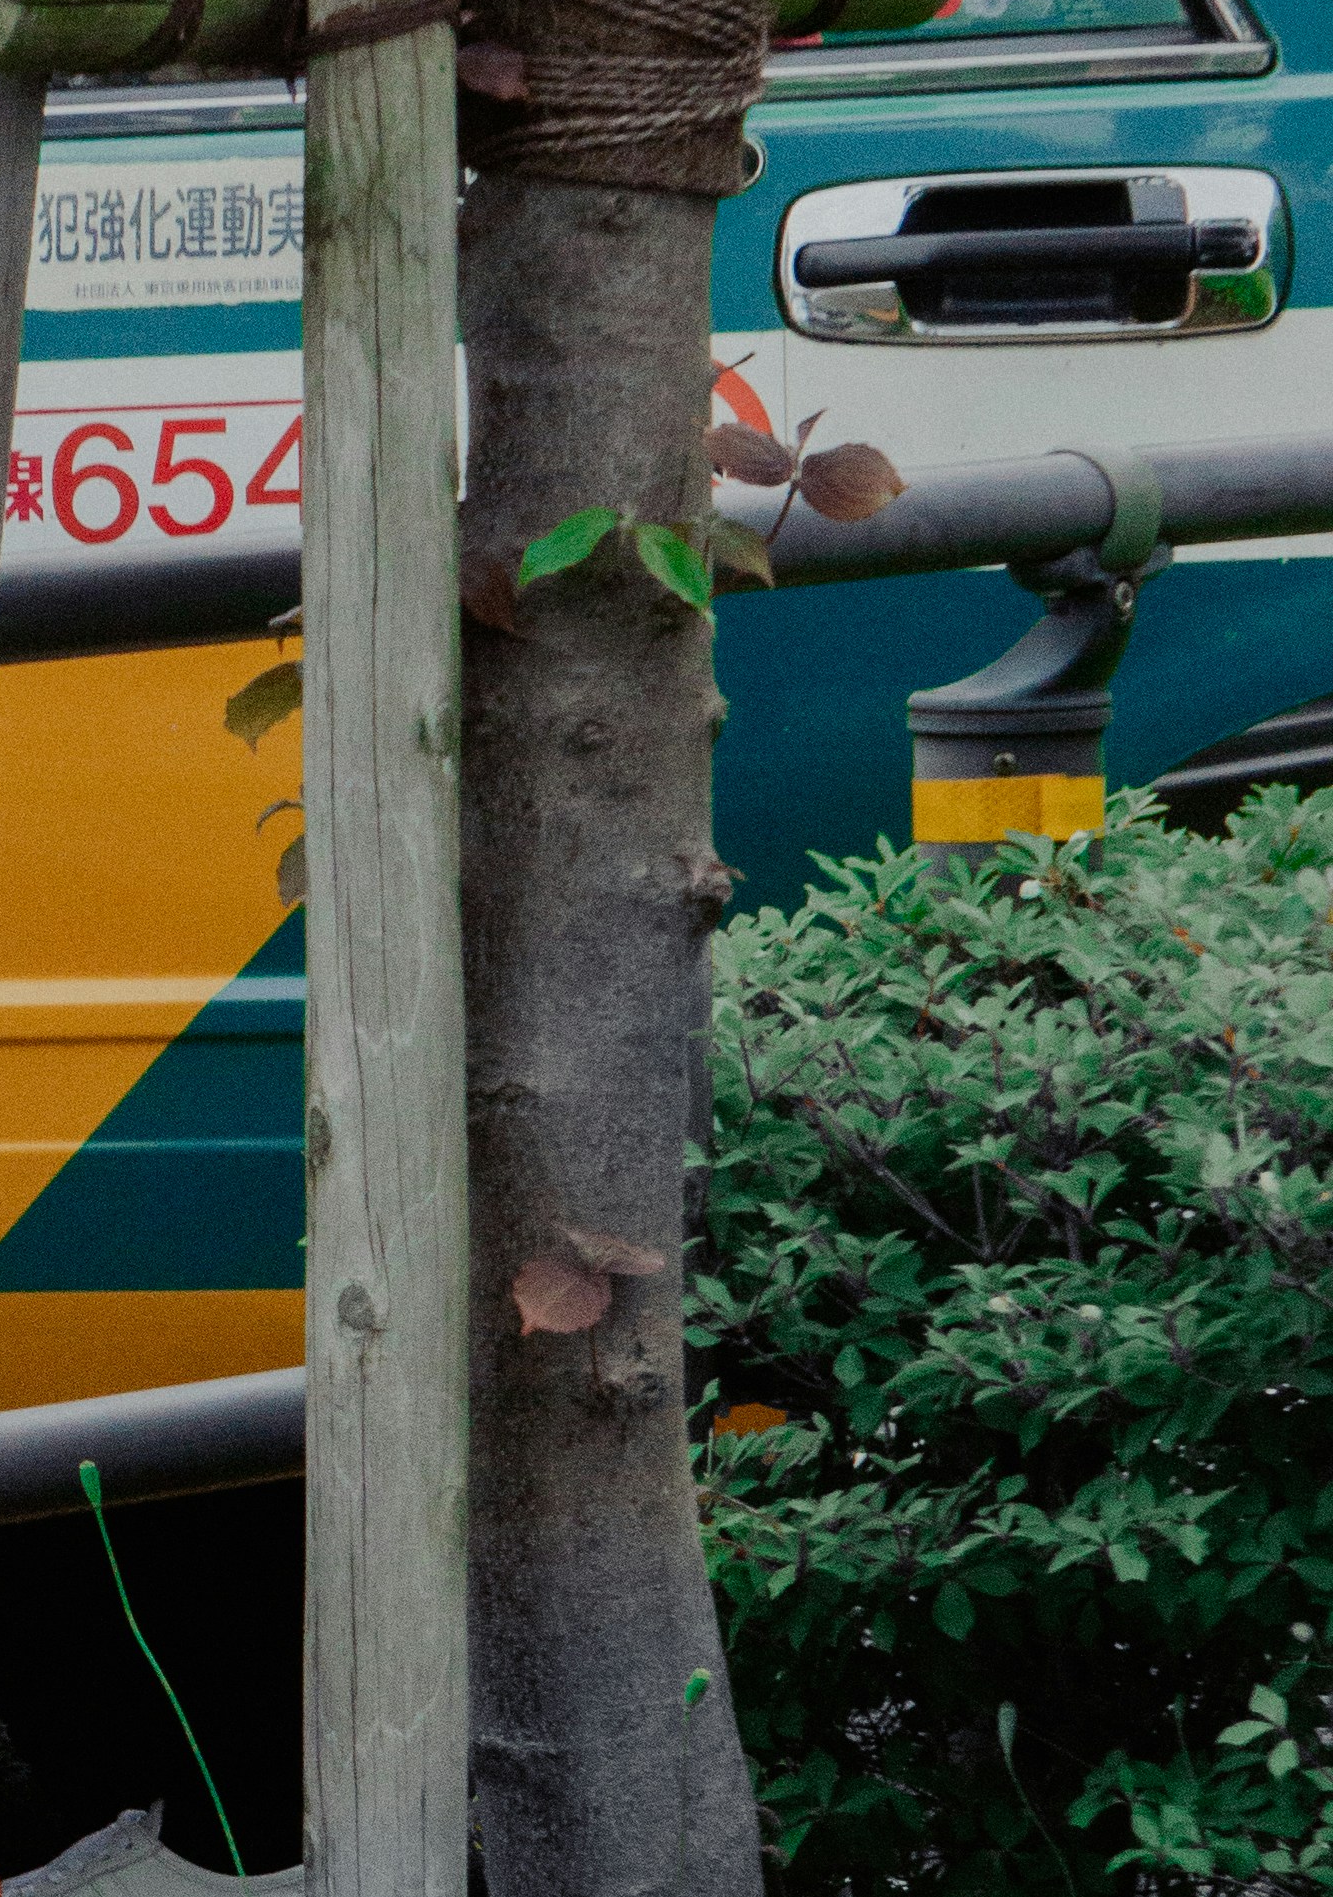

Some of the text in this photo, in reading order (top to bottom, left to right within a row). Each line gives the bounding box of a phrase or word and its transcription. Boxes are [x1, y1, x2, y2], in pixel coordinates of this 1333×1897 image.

[38, 182, 303, 264] 犯強化運動実
